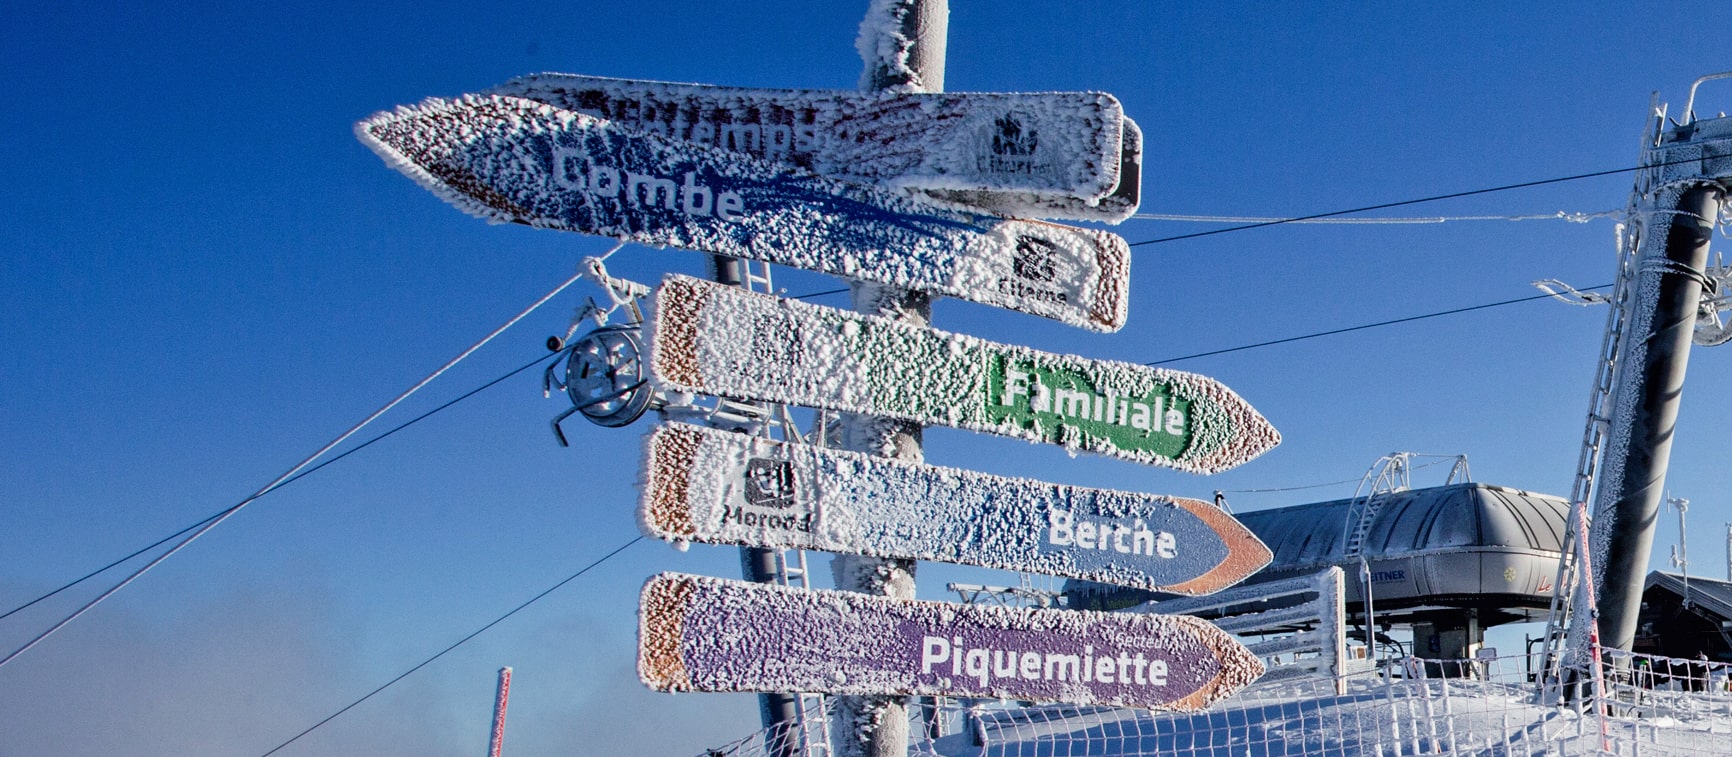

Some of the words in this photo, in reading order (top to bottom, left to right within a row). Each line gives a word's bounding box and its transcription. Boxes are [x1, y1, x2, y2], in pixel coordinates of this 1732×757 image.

[549, 147, 745, 222] Combe
[1002, 365, 1186, 436] Familiale
[1050, 507, 1178, 559] Berche
[1370, 570, 1405, 581] EITNER
[922, 636, 1168, 688] Piquemiette
